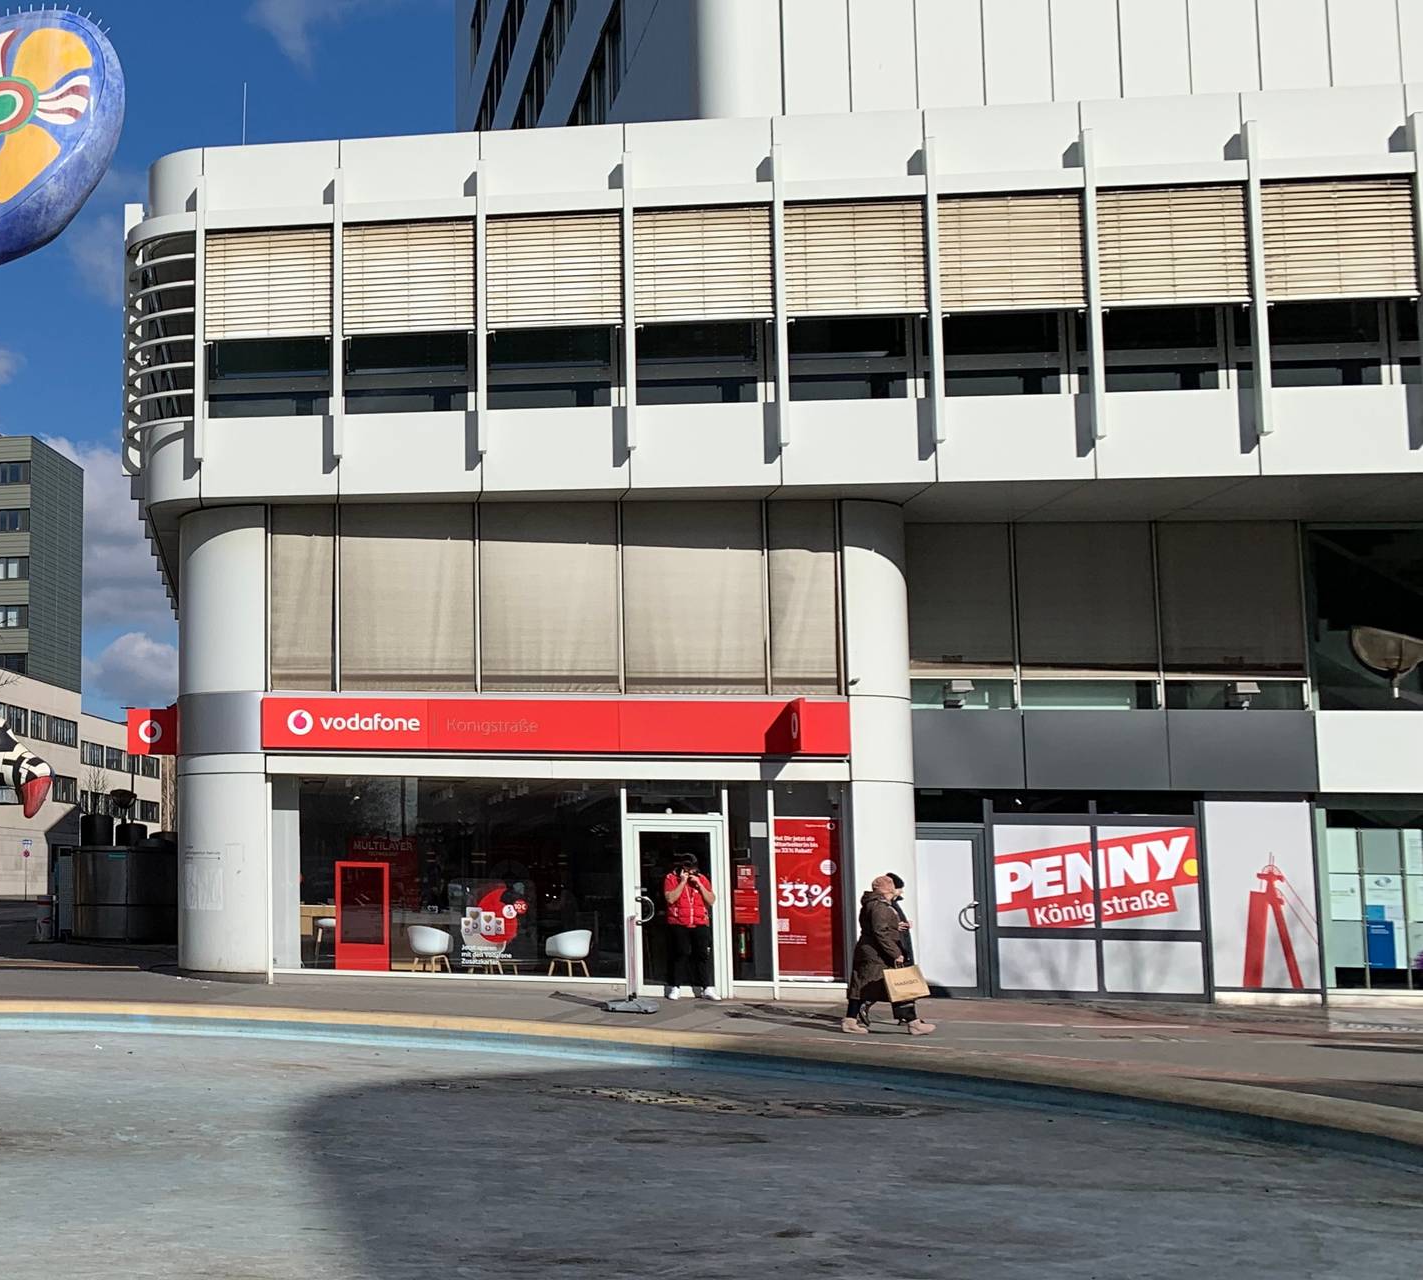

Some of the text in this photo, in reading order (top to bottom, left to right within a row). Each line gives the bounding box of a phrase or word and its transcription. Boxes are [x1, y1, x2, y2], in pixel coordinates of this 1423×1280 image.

[320, 713, 421, 732] vodafone
[353, 841, 413, 851] MULTILAYER
[778, 884, 833, 908] 33%
